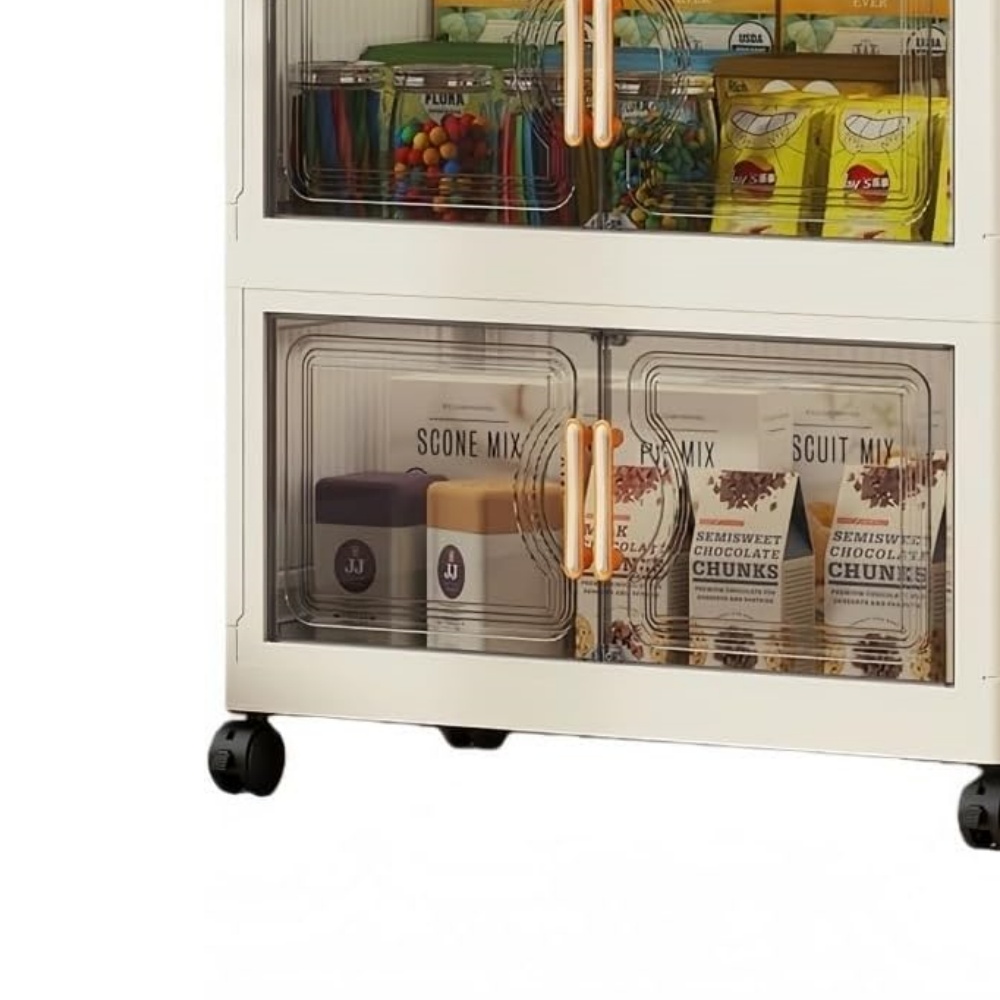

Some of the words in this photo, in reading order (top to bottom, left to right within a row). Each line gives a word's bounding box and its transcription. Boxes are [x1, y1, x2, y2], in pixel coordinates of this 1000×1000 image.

[738, 33, 764, 44] USDA
[417, 428, 478, 457] SCONE
[487, 430, 522, 459] MIX
[860, 437, 894, 465] MIX
[681, 441, 715, 468] MIX
[696, 531, 782, 545] SEMISWEET
[694, 545, 781, 559] CHOCOLATE
[344, 558, 365, 574] JJ
[443, 563, 459, 580] JJ
[692, 560, 779, 579] CHUNKS
